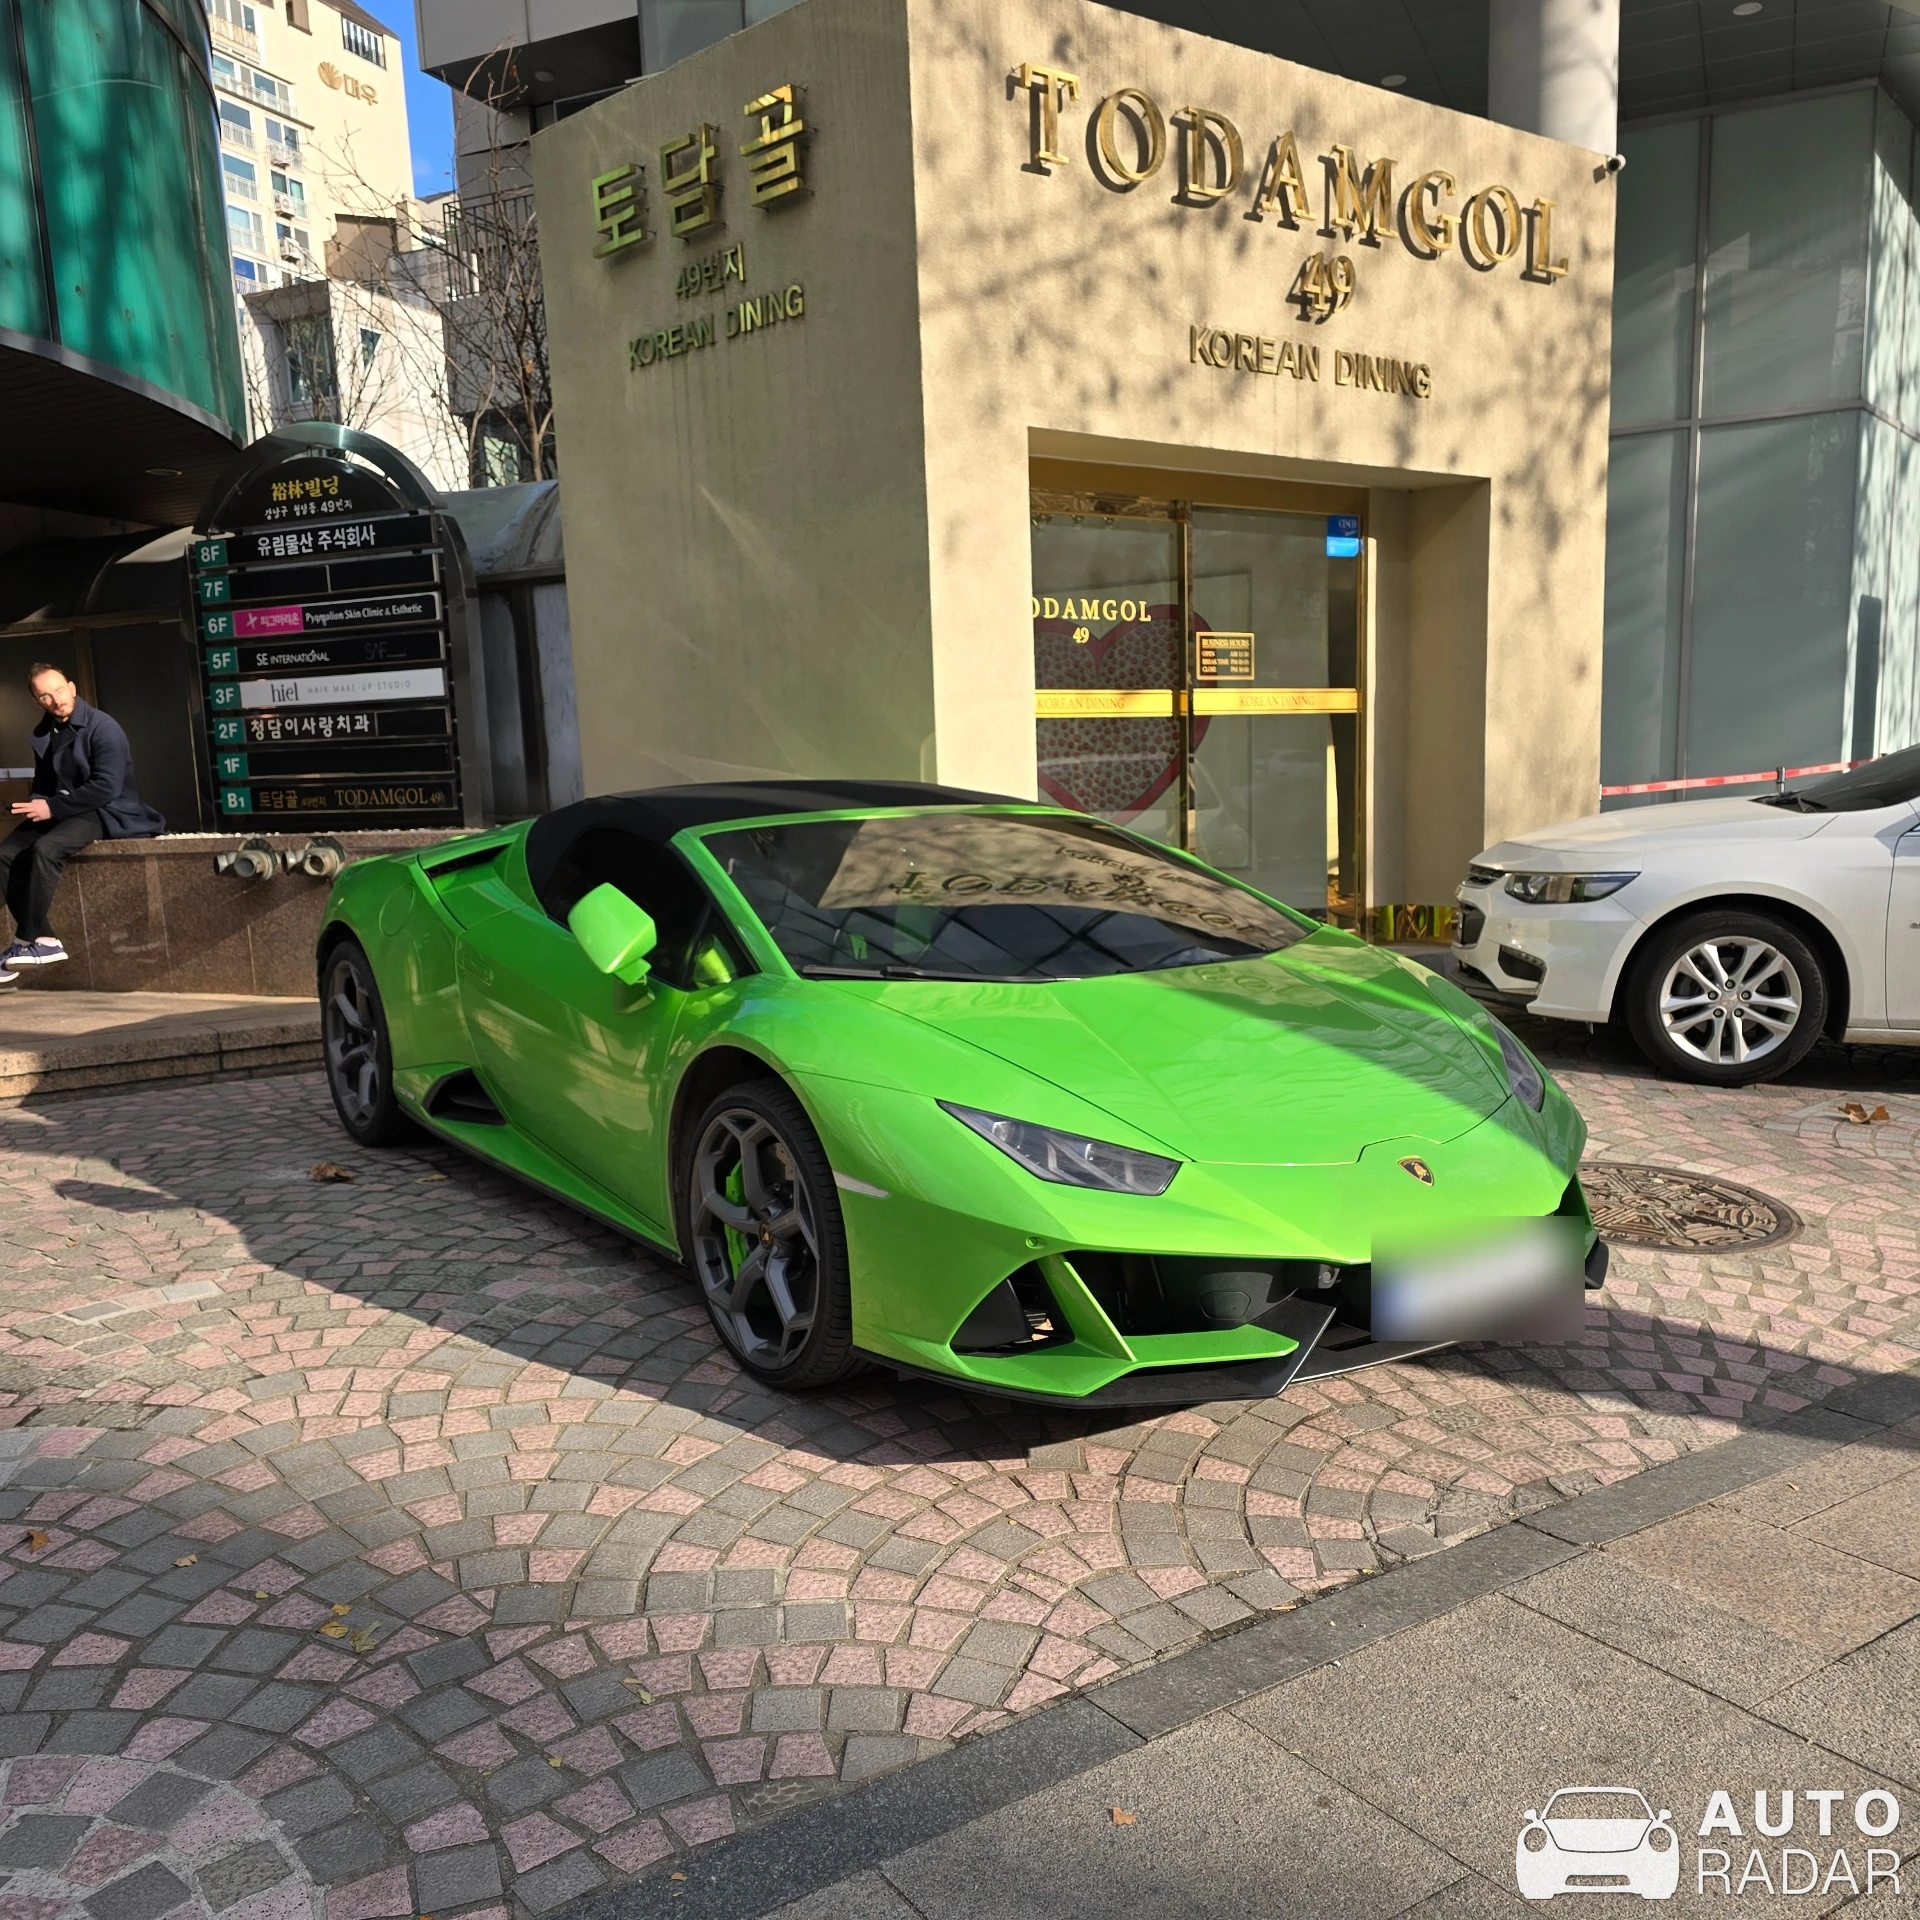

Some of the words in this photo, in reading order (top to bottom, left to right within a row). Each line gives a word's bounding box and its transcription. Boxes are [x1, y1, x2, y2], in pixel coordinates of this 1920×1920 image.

[342, 73, 378, 106] 대우
[592, 84, 803, 260] 토담골
[1020, 62, 1569, 278] TODAMGOL
[676, 242, 745, 299] 49번지
[1303, 252, 1356, 315] 49
[628, 314, 715, 370] KOREAN
[727, 284, 804, 339] DINING
[1189, 325, 1320, 382] KOREAN
[1336, 349, 1432, 399] DINING
[257, 530, 314, 557] 유림물산
[317, 524, 376, 552] 주식회사
[201, 545, 220, 562] 8F
[204, 581, 223, 598] 7F
[344, 608, 361, 620] Skin
[361, 606, 384, 618] Clinic
[208, 616, 228, 634] 6F
[1072, 627, 1090, 644] 49
[212, 653, 231, 670] 5F
[256, 653, 269, 666] SE
[270, 650, 330, 664] INTERNATIONAL
[215, 687, 234, 705] 3F
[270, 682, 299, 703] hiel
[307, 686, 328, 695] HAIR
[333, 682, 372, 693] MAKE-UP
[377, 680, 411, 691] STUDIO
[1036, 697, 1083, 710] KOREAN
[1086, 697, 1126, 710] DINING
[1239, 695, 1279, 707] KOREAN
[1281, 695, 1315, 706] DINING
[219, 723, 238, 739] 2F
[250, 713, 370, 741] 청담이사랑치과
[224, 757, 240, 773] 1F
[227, 792, 245, 808] B1
[334, 787, 429, 807] TODAMGOL
[430, 792, 441, 803] 49
